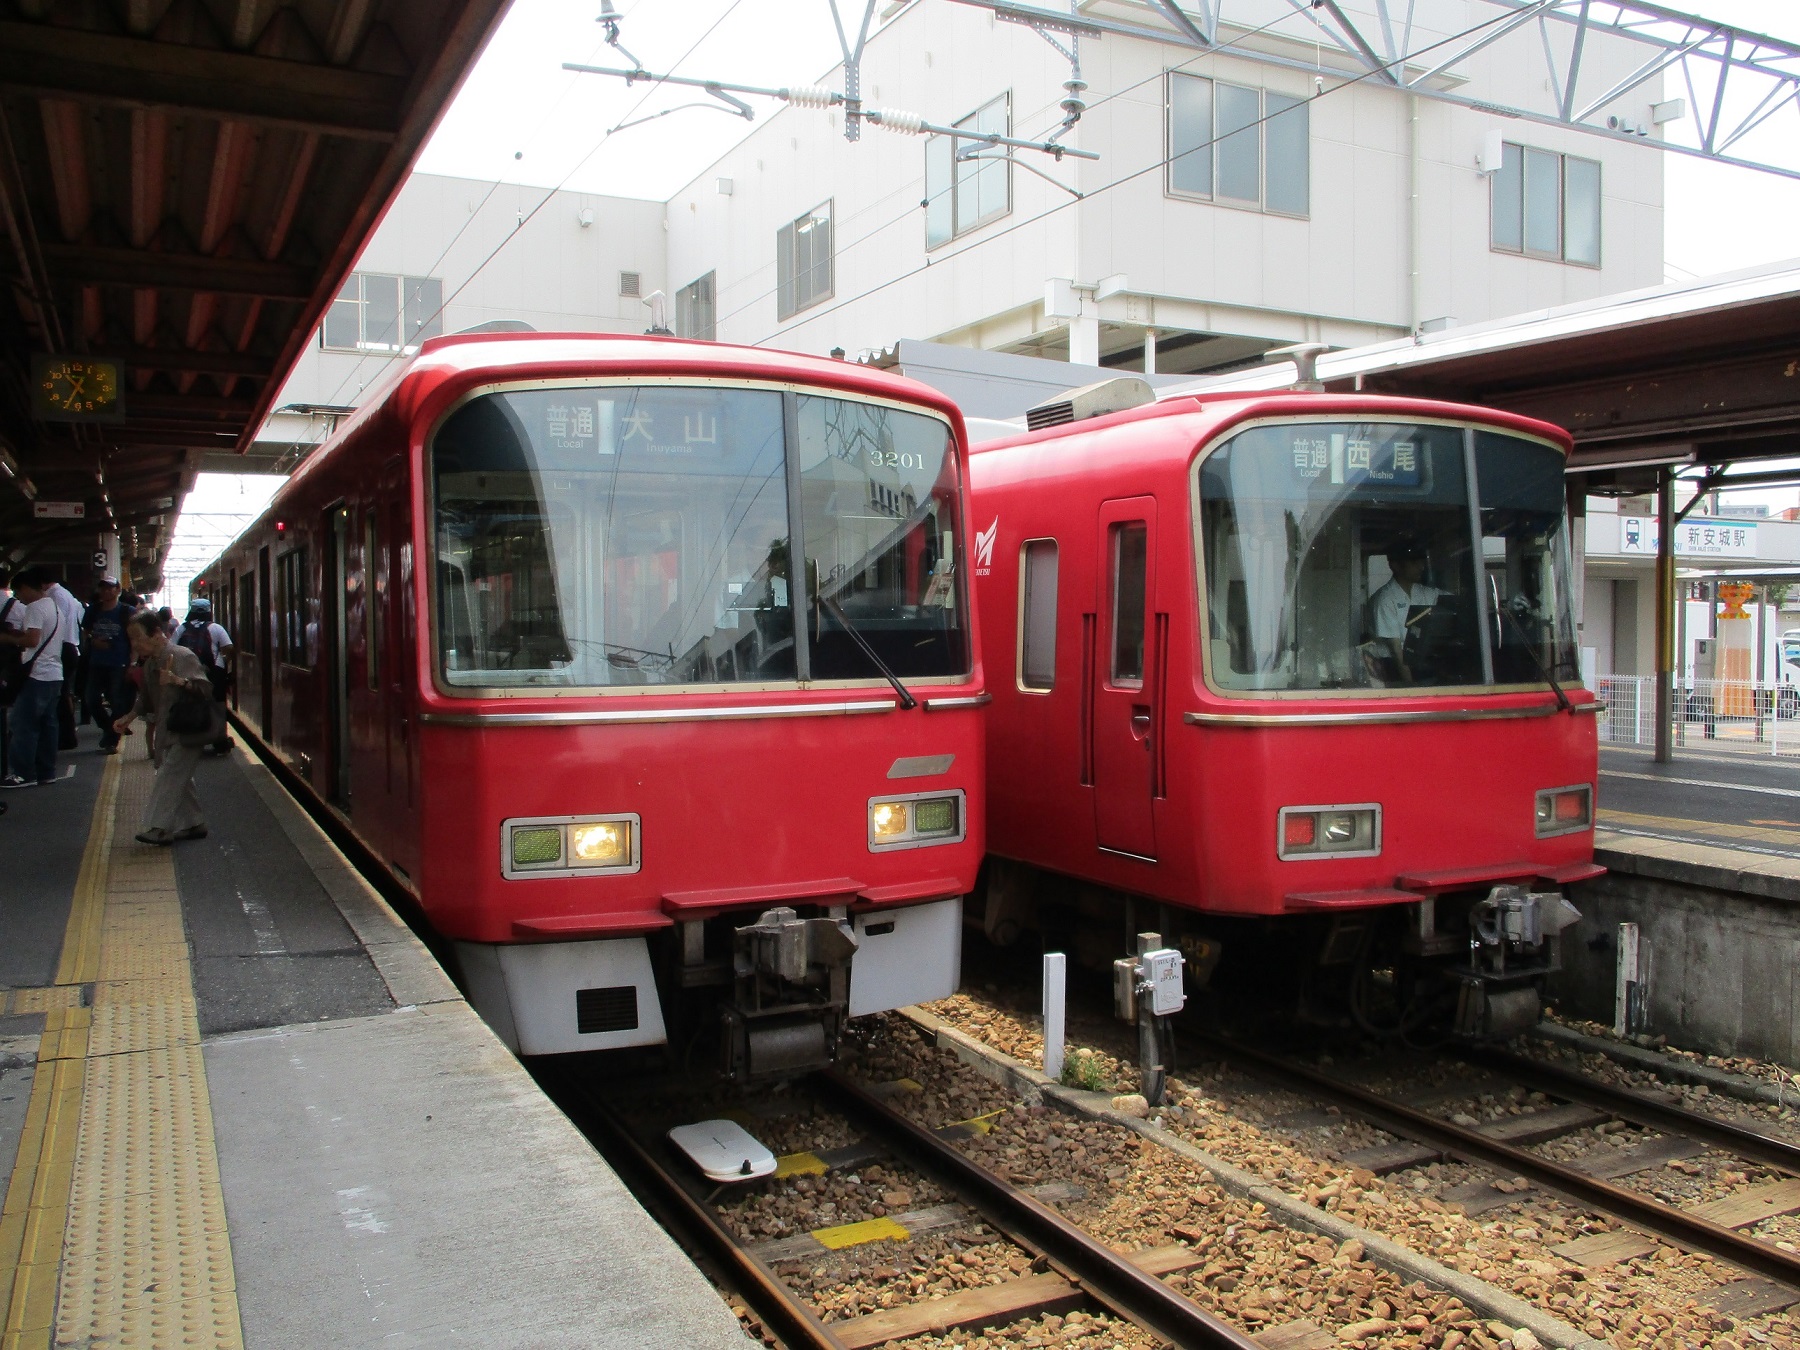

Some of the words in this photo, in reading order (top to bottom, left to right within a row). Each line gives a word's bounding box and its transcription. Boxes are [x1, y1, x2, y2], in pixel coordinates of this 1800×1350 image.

[546, 404, 594, 438] 普通
[622, 409, 716, 444] 犬山
[557, 439, 584, 449] Local
[646, 444, 692, 454] Inuyama
[870, 450, 925, 470] 3201
[1293, 438, 1327, 468] 普通
[1347, 440, 1416, 472] 西尾
[1300, 468, 1320, 478] Local
[1369, 470, 1394, 480] Nishio
[1688, 527, 1746, 548] 新安城駅
[94, 552, 107, 567] 3
